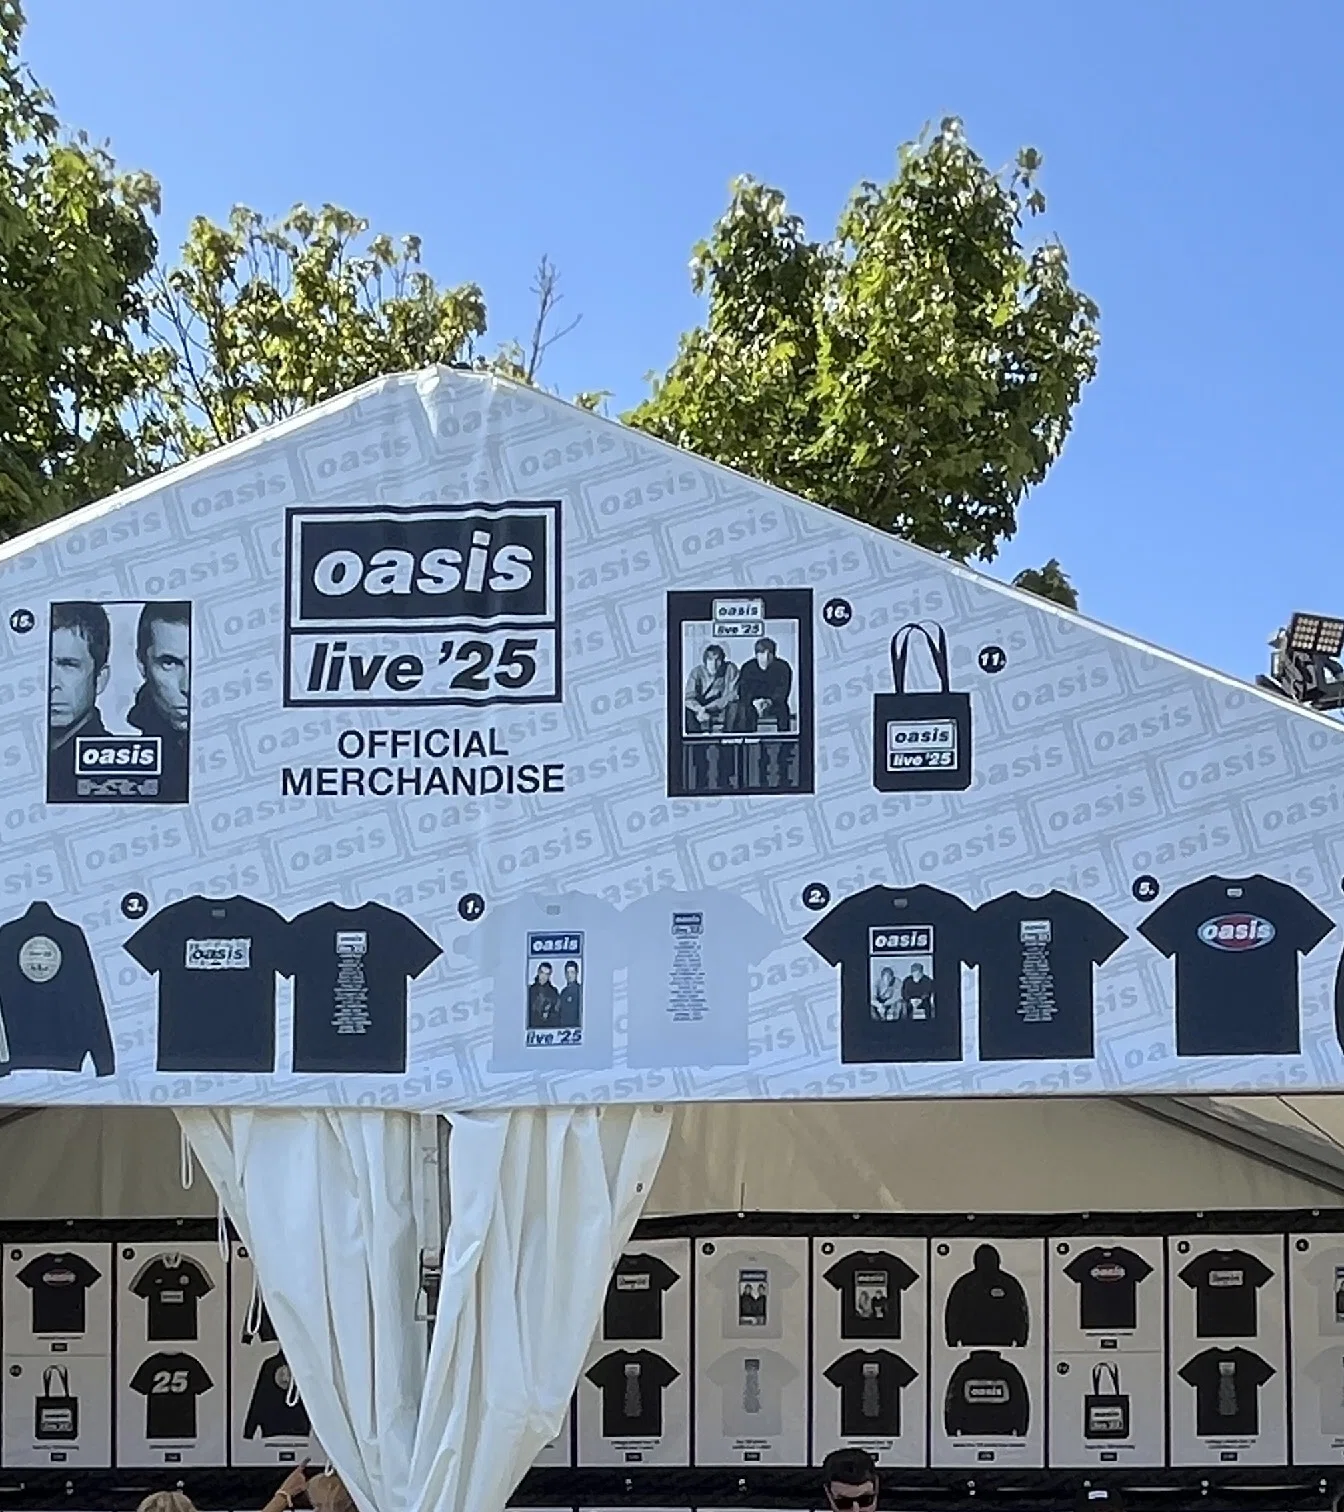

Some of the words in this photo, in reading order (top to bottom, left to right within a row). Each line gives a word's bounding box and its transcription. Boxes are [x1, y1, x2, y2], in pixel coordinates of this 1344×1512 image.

[317, 431, 412, 479] oasis
[520, 427, 616, 478] oasis
[191, 469, 287, 518] oasis
[599, 466, 698, 516] oasis
[66, 503, 162, 555] oasis
[683, 505, 778, 555] oasis
[144, 546, 239, 596] oasis
[312, 529, 535, 597] oasis
[718, 603, 759, 617] oasis
[306, 641, 424, 692] live
[979, 652, 1005, 668] 11.
[1013, 658, 1109, 711] oasis
[258, 707, 353, 755] oasis
[337, 727, 511, 760] OFFICIAL
[894, 726, 950, 744] oasis
[1094, 699, 1193, 751] oasis
[82, 744, 155, 765] oasis
[892, 753, 924, 767] live
[1178, 739, 1276, 791] oasis
[280, 763, 566, 798] MERCHANDISE
[1048, 781, 1147, 831] oasis
[86, 822, 182, 871] oasis
[290, 823, 386, 872] oasis
[497, 824, 593, 875] oasis
[708, 822, 805, 872] oasis
[918, 821, 1018, 872] oasis
[1131, 819, 1231, 872] oasis
[467, 899, 481, 915] 1.
[809, 889, 826, 904] 2.
[1138, 880, 1155, 896] 5.
[532, 936, 579, 953] oasis
[875, 930, 930, 948] oasis
[1203, 919, 1271, 941] oasis
[526, 1030, 554, 1045] live
[151, 1370, 190, 1394] 25
